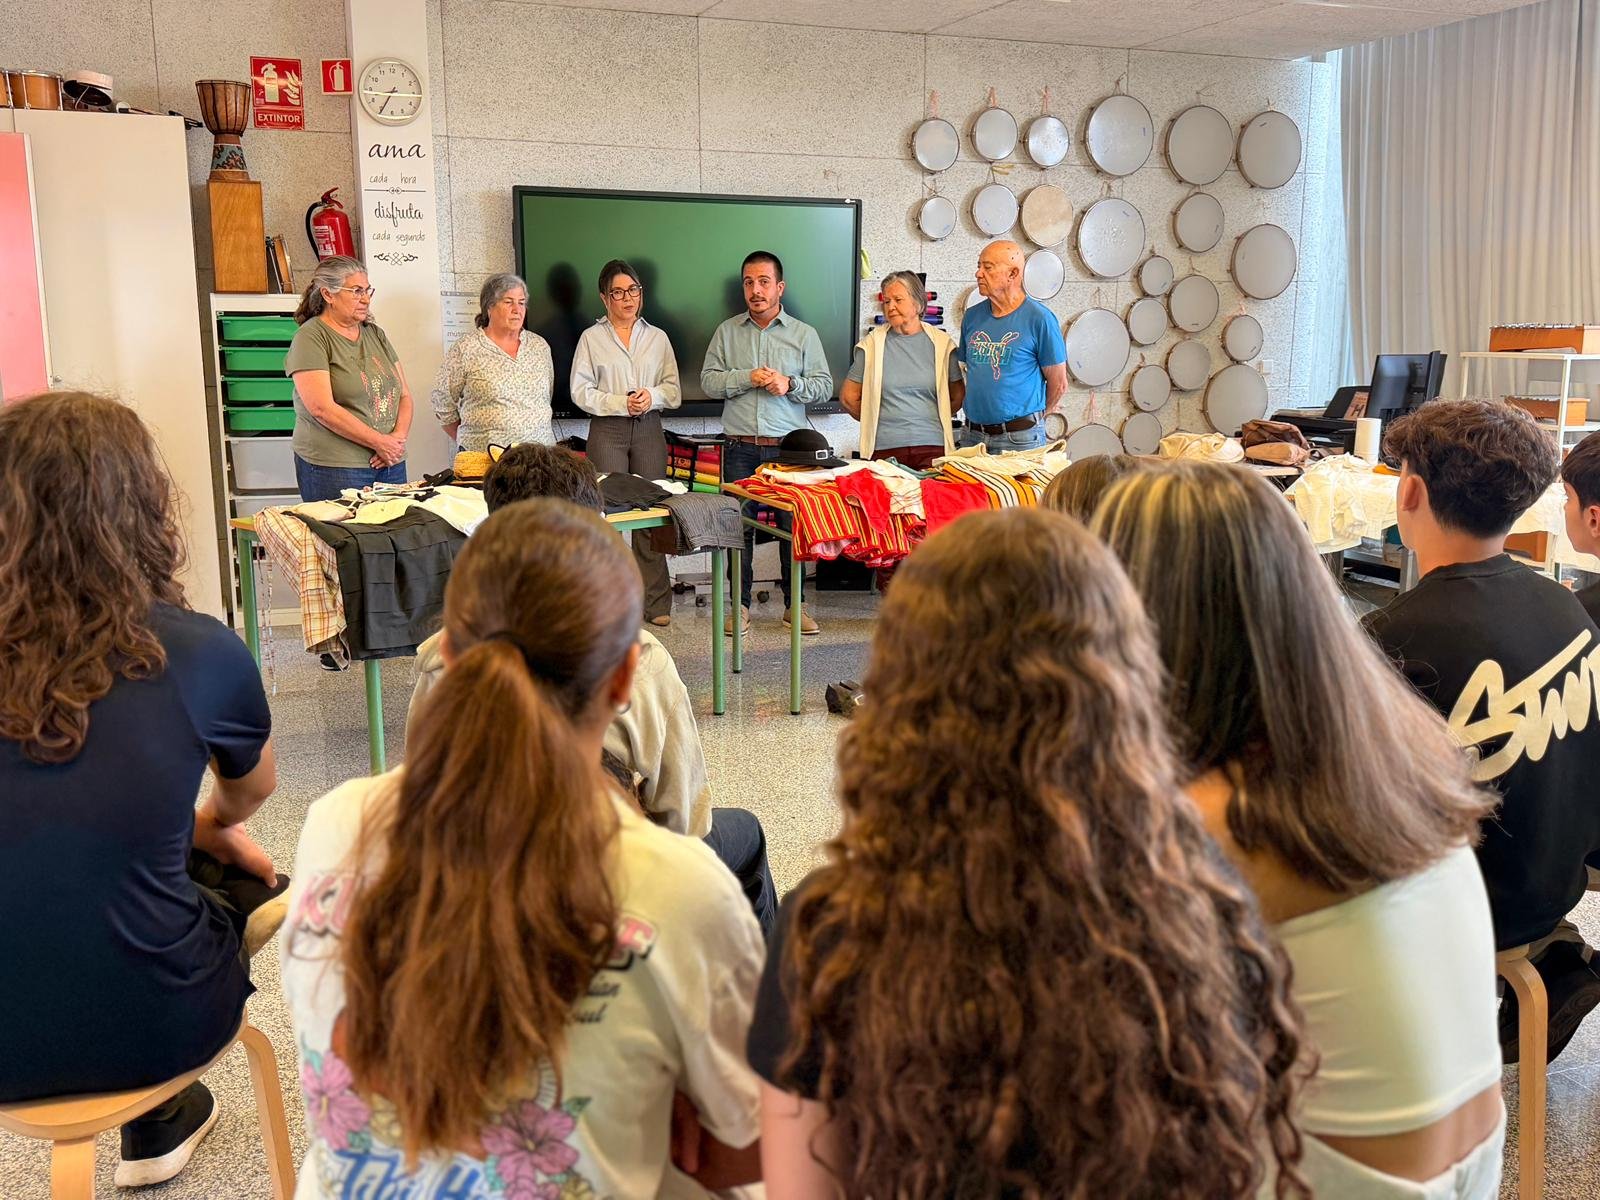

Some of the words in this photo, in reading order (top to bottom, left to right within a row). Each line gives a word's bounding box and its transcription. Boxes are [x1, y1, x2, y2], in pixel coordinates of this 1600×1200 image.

[257, 113, 301, 123] EXTINTOR
[368, 143, 426, 159] ama
[369, 171, 388, 184] cada
[400, 171, 417, 184] hora
[374, 201, 424, 228] disfruta
[372, 229, 391, 241] cada
[395, 229, 426, 246] segundo
